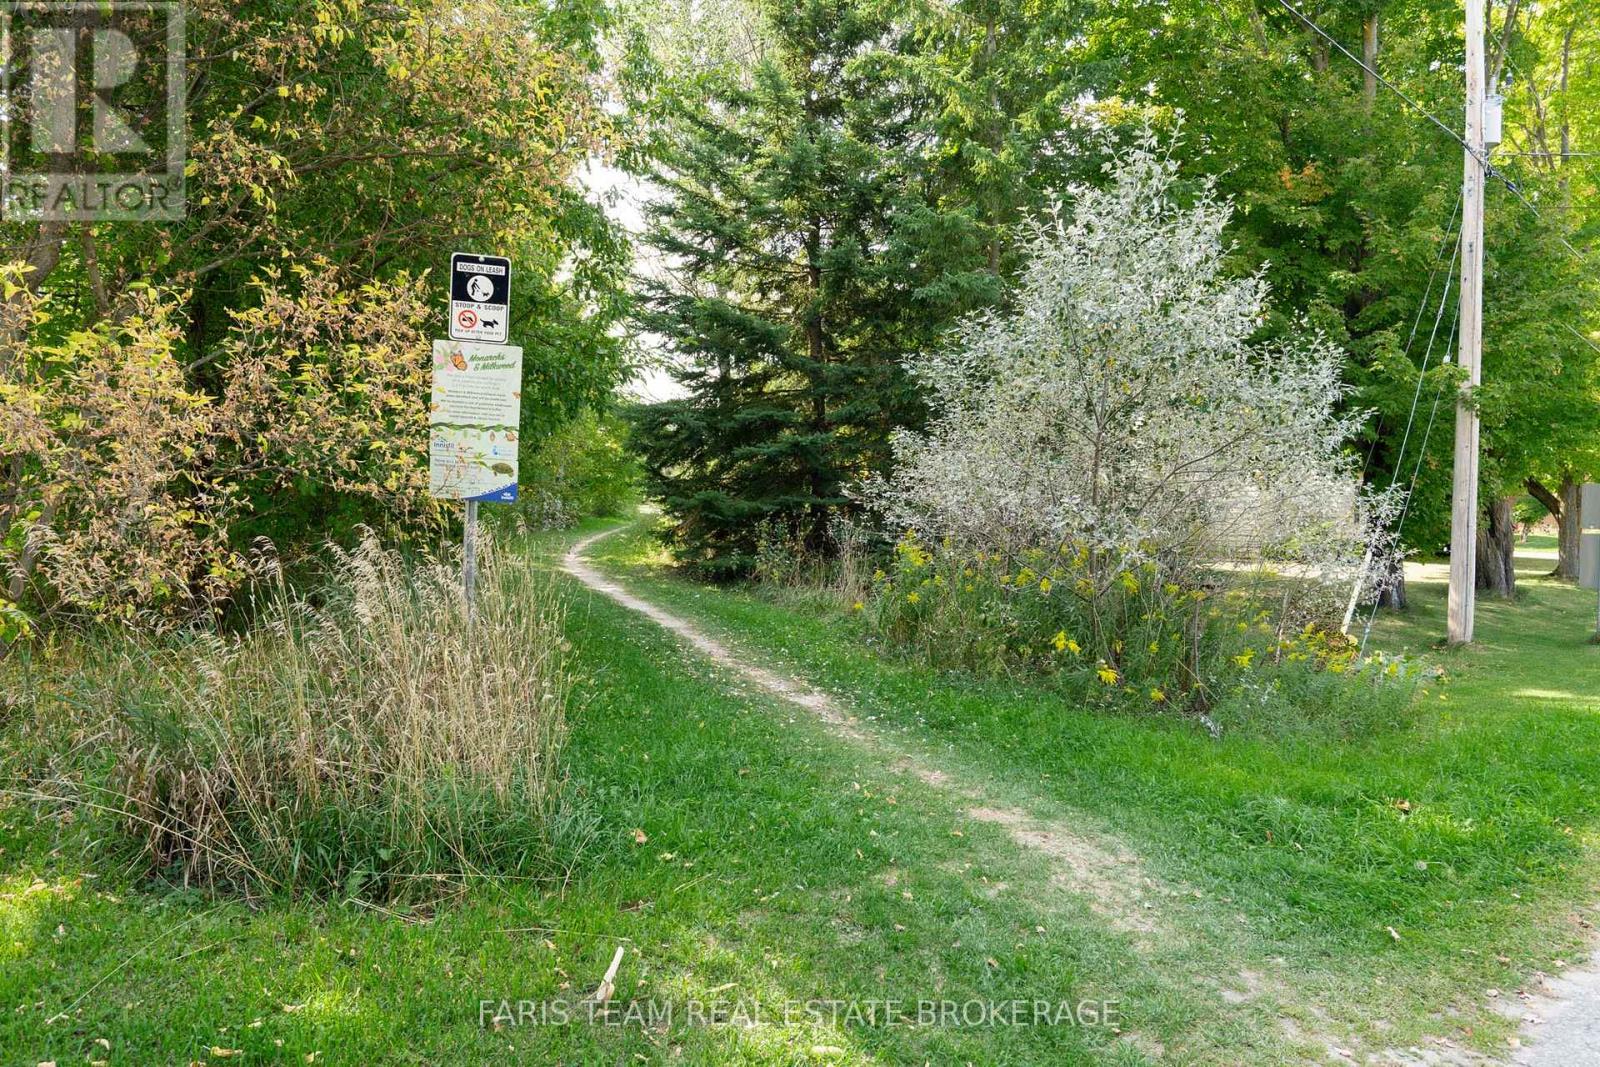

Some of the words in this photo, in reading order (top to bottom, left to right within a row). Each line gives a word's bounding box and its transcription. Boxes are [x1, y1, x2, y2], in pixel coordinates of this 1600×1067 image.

[459, 264, 475, 272] DOGS
[477, 265, 485, 273] ON
[486, 266, 503, 274] LEASH
